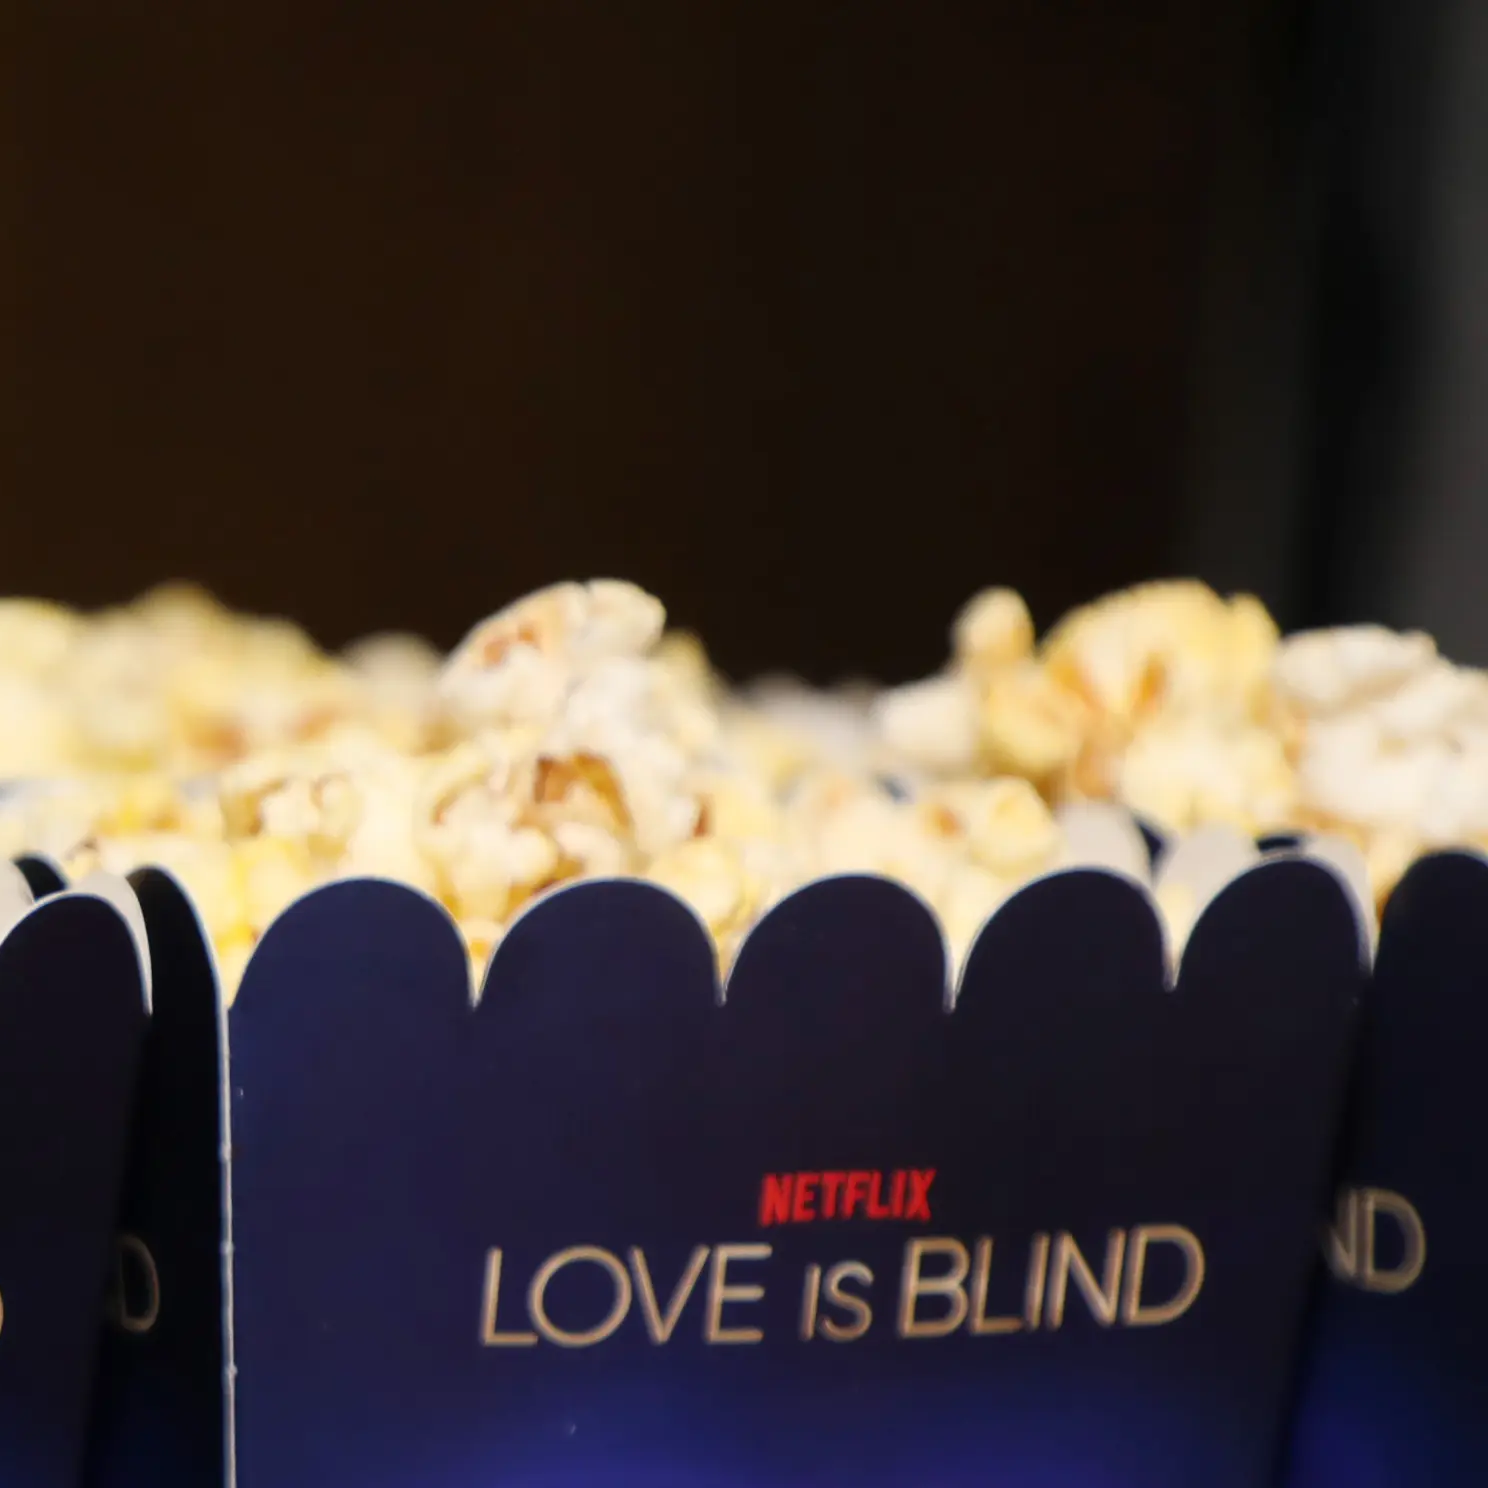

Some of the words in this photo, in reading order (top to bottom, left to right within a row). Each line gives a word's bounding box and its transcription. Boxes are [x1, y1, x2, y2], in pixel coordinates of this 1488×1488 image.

[758, 1168, 936, 1226] NETFLIX
[480, 1243, 773, 1348] LOVE
[801, 1260, 875, 1342] IS
[898, 1223, 1206, 1339] BLIND
